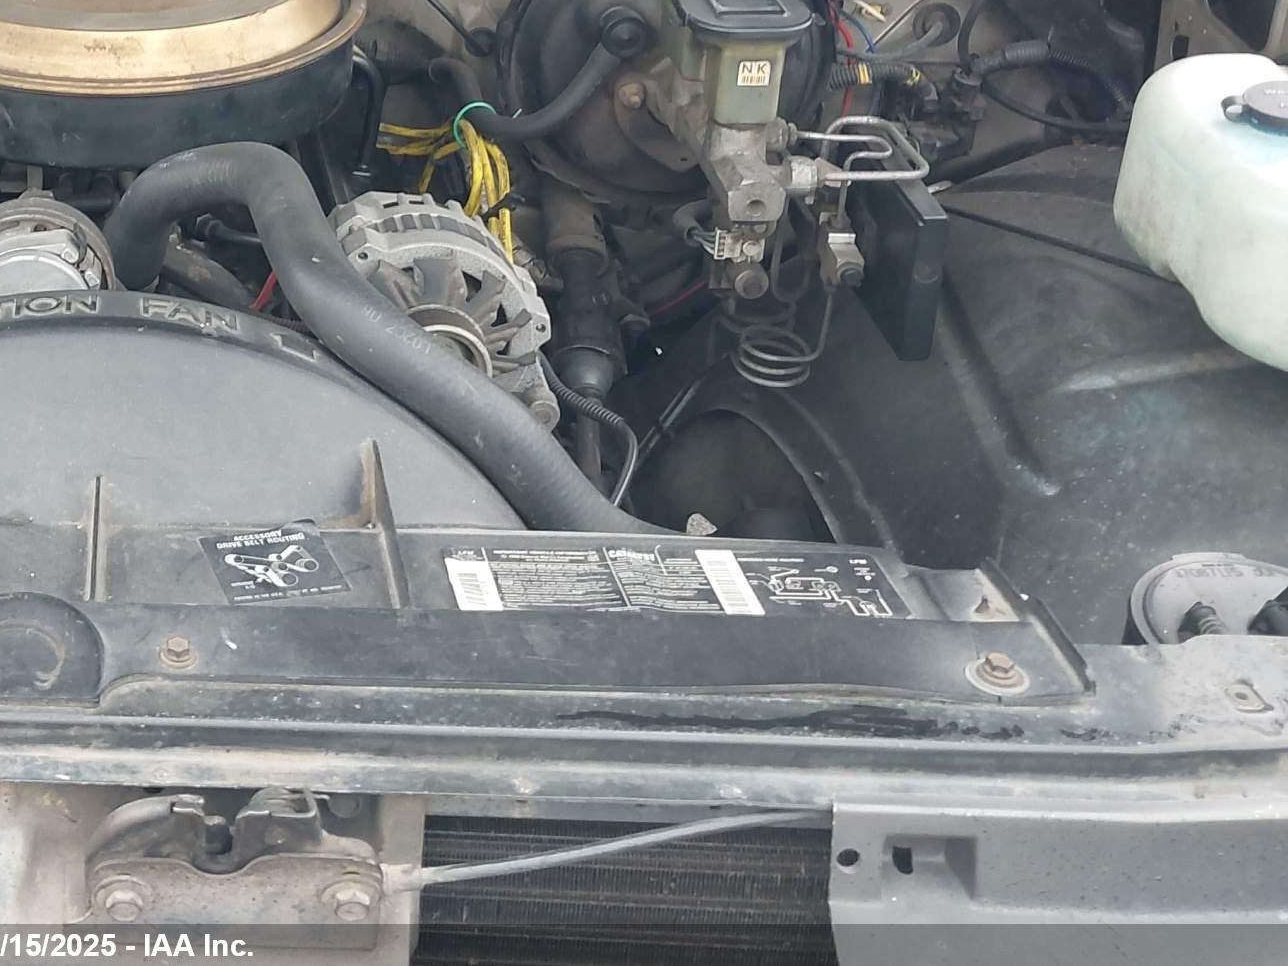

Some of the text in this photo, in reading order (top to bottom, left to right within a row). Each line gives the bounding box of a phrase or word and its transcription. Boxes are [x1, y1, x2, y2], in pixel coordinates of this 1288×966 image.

[139, 297, 241, 335] FAN
[233, 530, 282, 542] ACCESSORY
[216, 541, 242, 549] DRIVE
[244, 538, 265, 547] BELT
